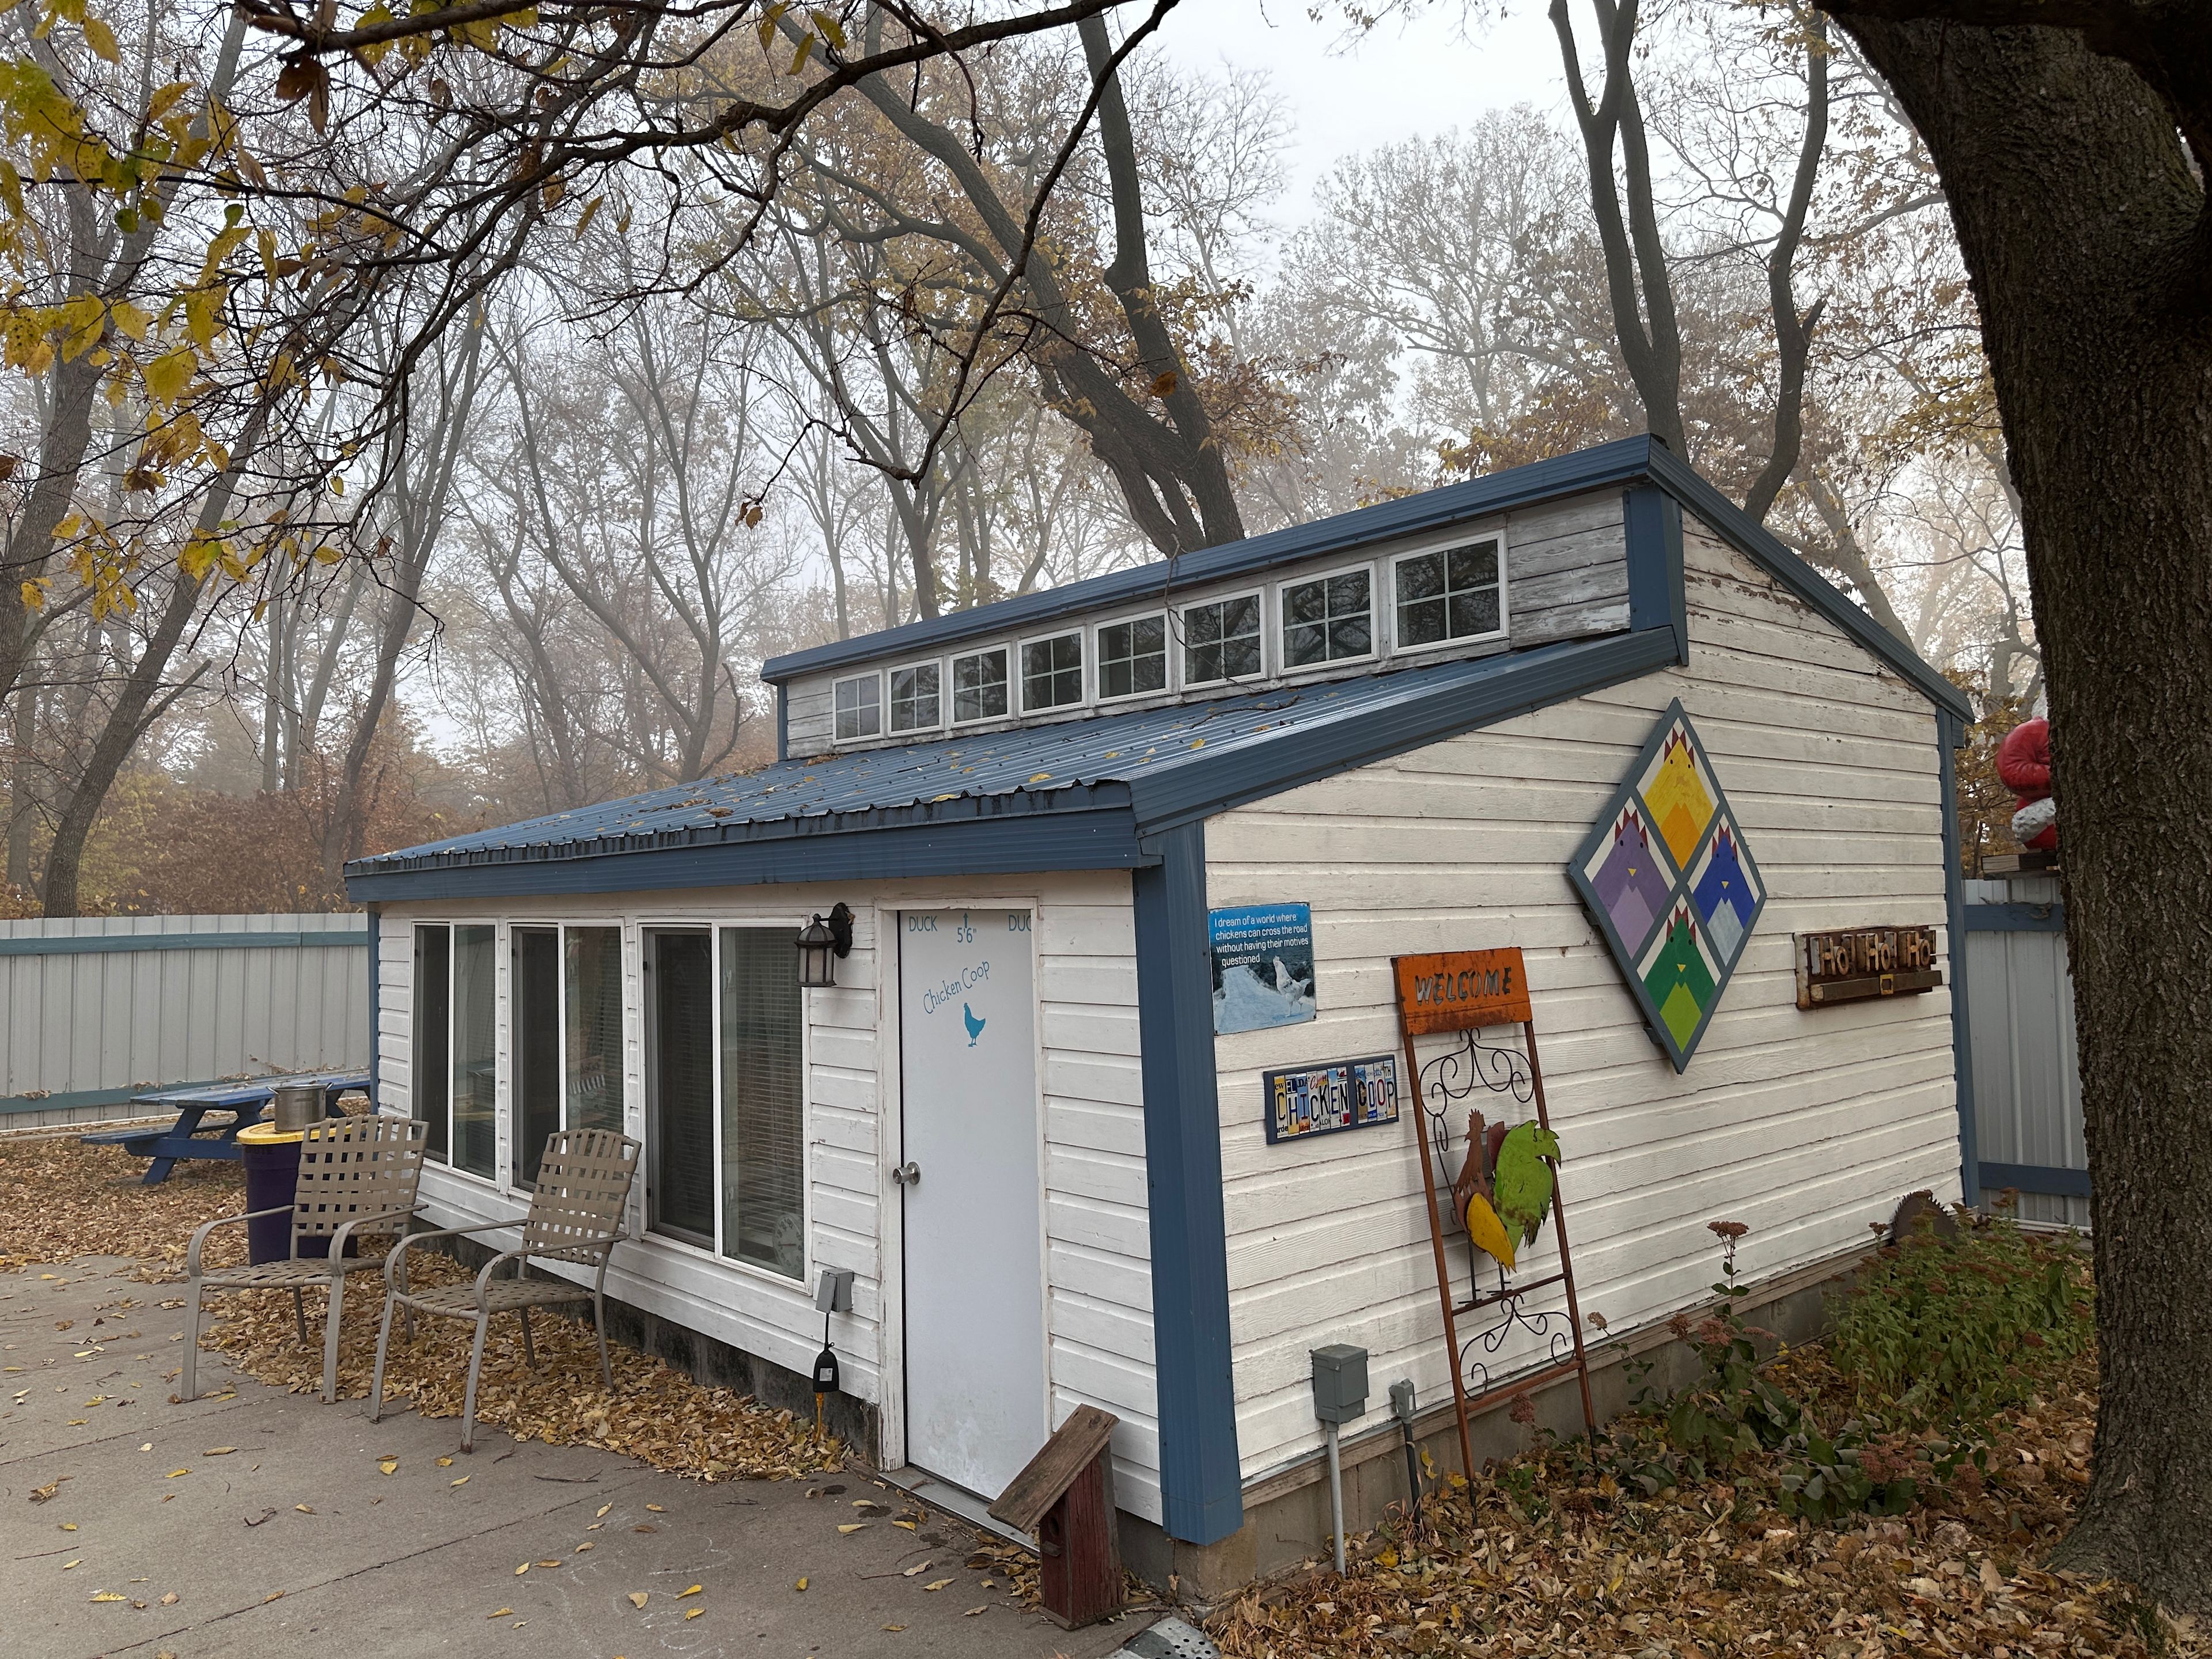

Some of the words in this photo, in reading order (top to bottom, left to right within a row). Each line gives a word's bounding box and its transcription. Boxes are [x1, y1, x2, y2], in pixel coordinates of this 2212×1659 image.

[909, 916, 938, 931] DUCK
[1218, 918, 1241, 927] dream
[1243, 915, 1251, 925] of
[1251, 916, 1255, 925] a
[1256, 914, 1275, 924] world
[1276, 913, 1297, 922] where
[1215, 929, 1247, 940] chickens
[1248, 929, 1261, 938] can
[1262, 927, 1281, 937] cross
[1282, 925, 1293, 934] the
[1293, 924, 1308, 933] road
[1216, 942, 1243, 953] without
[1244, 940, 1266, 951] having
[1267, 938, 1283, 948] their
[1283, 937, 1309, 947] motives
[1221, 953, 1260, 968] questioned
[923, 980, 962, 1014] Chicken
[962, 961, 990, 988] Coop
[1415, 966, 1512, 1006] WELCOME
[1277, 1082, 1349, 1126] CHICKEN
[1358, 1078, 1394, 1108] COOP
